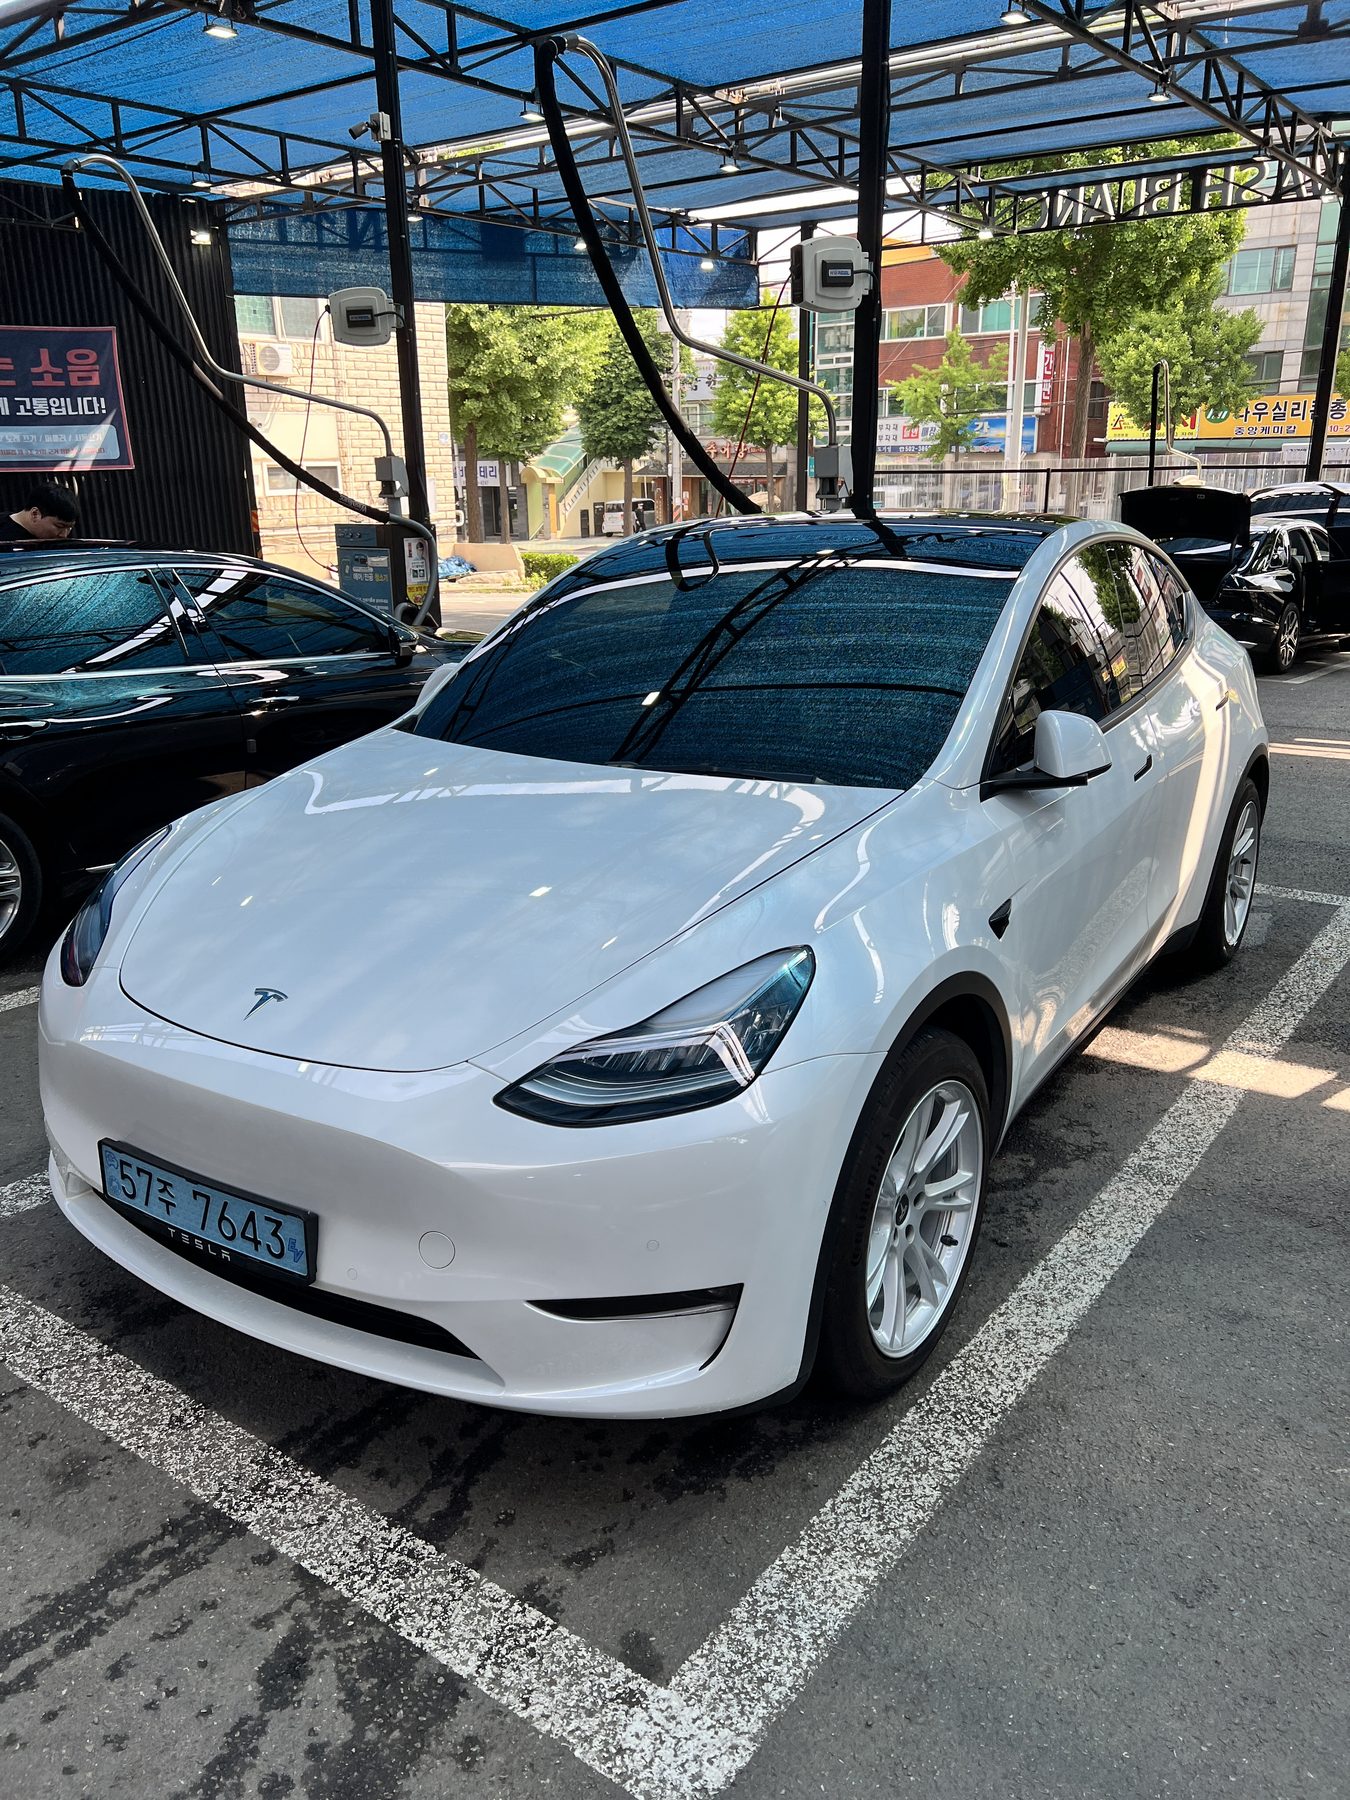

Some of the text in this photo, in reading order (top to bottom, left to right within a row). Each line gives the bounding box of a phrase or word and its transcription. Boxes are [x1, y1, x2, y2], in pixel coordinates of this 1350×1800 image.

[30, 348, 101, 387] 소음
[14, 396, 107, 416] 고통입니다!
[1234, 425, 1297, 436] 중앙케미칼
[118, 1158, 286, 1260] 57주 7643
[167, 1226, 231, 1262] TESLA
[287, 1238, 304, 1263] EV
